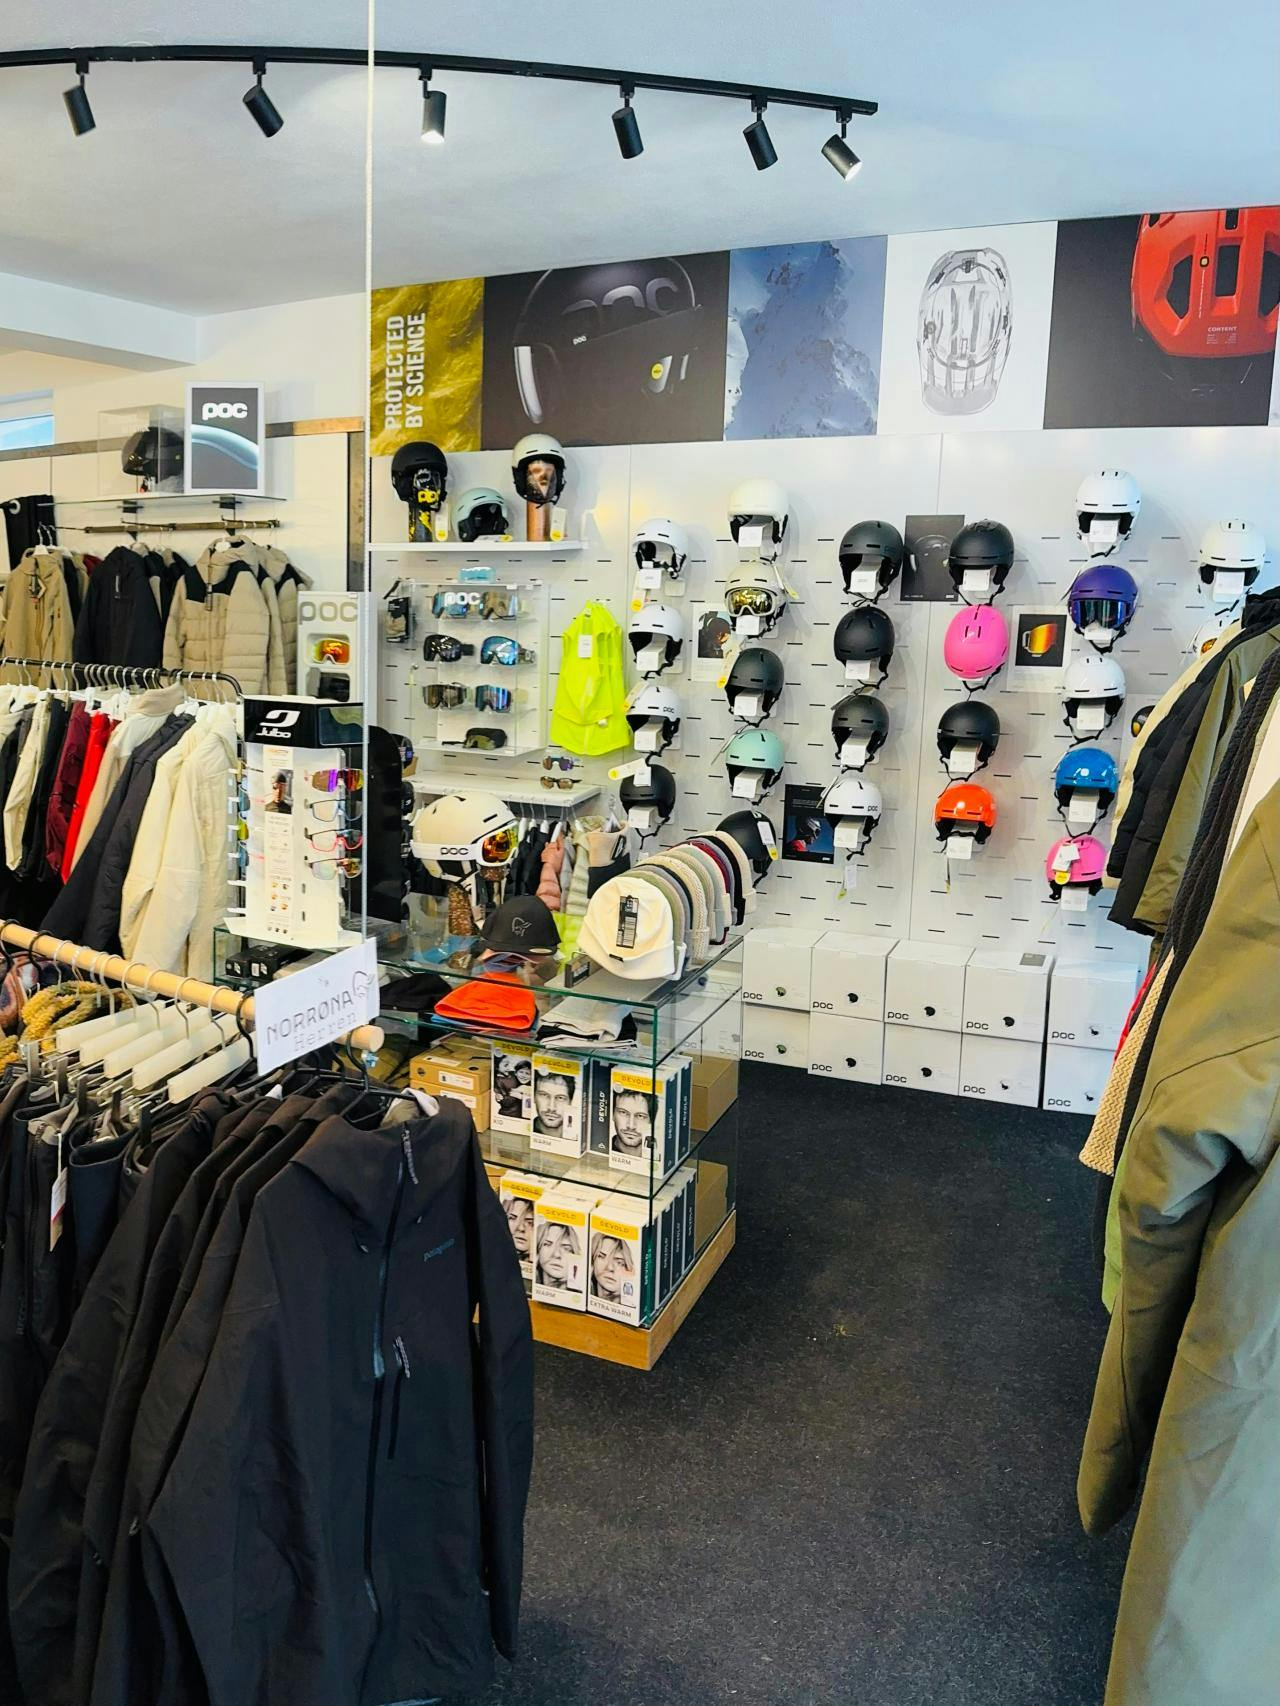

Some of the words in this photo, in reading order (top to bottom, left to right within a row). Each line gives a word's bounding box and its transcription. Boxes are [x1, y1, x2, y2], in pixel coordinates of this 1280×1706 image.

[406, 312, 426, 398] SCIENCE
[385, 315, 405, 431] PROTECTED
[201, 402, 248, 421] poc
[405, 406, 423, 428] BY
[444, 591, 480, 607] poc
[299, 601, 358, 625] poc
[440, 847, 469, 856] poc
[743, 991, 763, 1001] poc
[812, 1001, 834, 1010] poc
[887, 1011, 909, 1021] poc
[966, 1021, 989, 1030] poc
[1051, 1031, 1076, 1040] poc
[744, 1050, 765, 1059] poc
[811, 1063, 833, 1073] poc
[622, 1075, 650, 1086] DEVOLD
[885, 1074, 907, 1084] poc
[963, 1084, 986, 1095] poc
[1047, 1098, 1072, 1107] poc
[611, 1156, 631, 1166] WARM
[600, 1221, 629, 1233] DEVOLD
[590, 1301, 610, 1311] EXTRA
[611, 1306, 631, 1317] WARM
